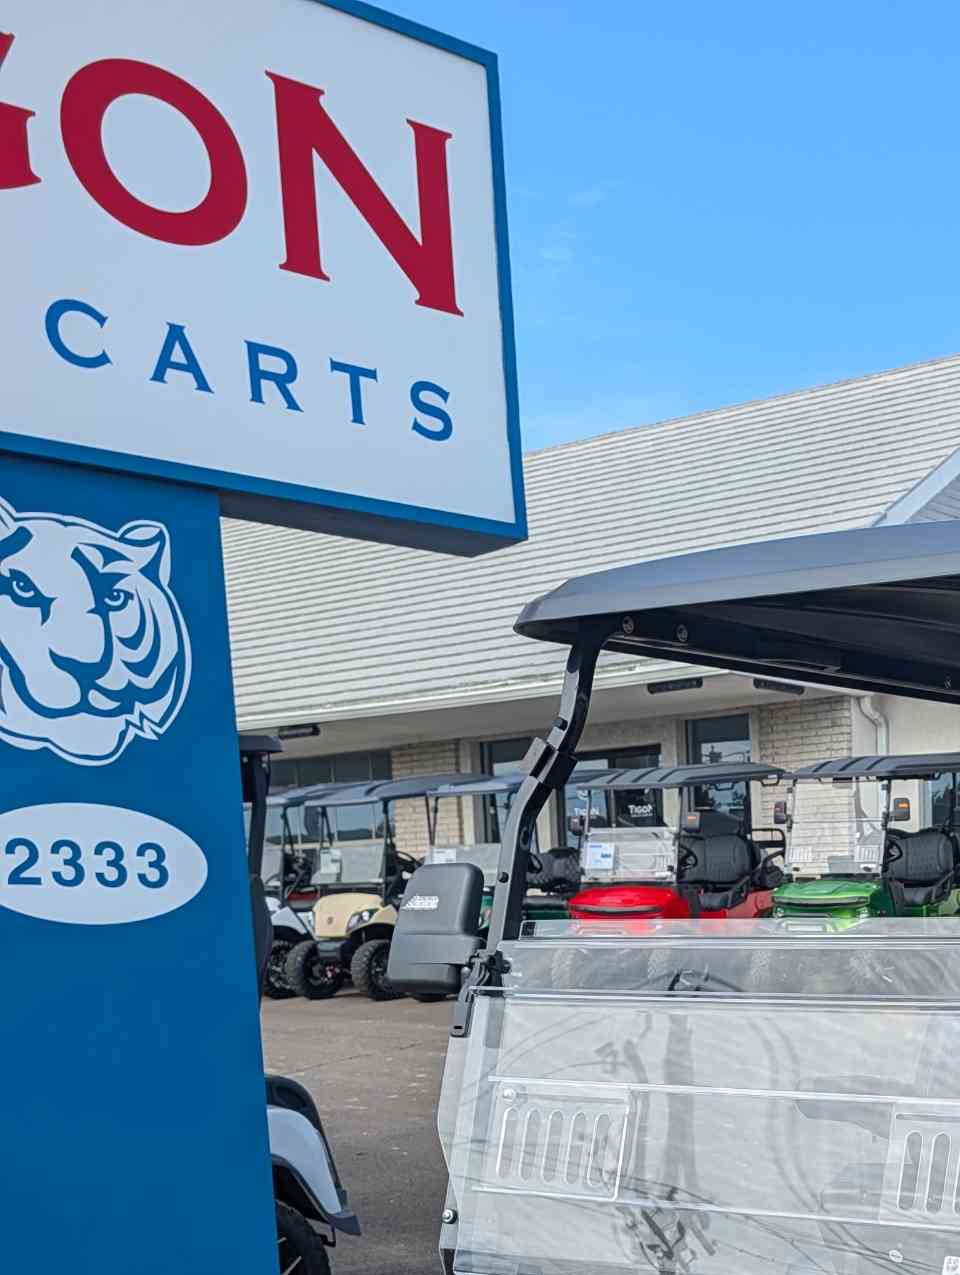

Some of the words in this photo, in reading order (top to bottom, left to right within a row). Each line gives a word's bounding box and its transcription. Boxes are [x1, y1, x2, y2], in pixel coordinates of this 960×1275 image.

[0, 32, 464, 317] ON
[44, 298, 454, 442] CARTS
[574, 807, 600, 816] TIGN
[5, 838, 169, 888] 2333
